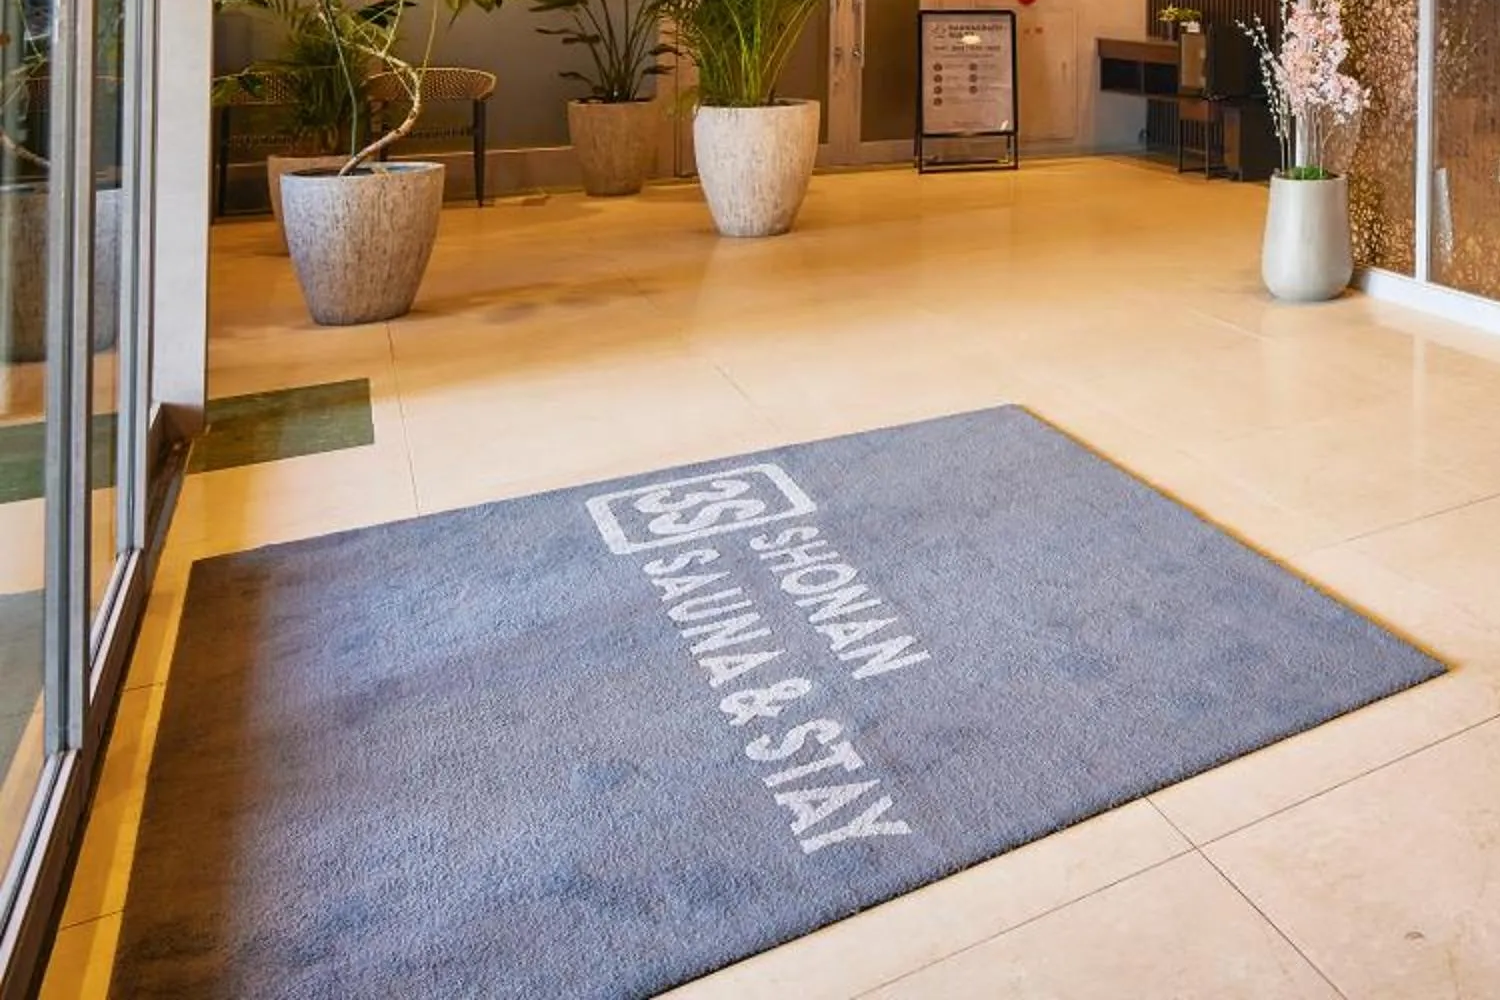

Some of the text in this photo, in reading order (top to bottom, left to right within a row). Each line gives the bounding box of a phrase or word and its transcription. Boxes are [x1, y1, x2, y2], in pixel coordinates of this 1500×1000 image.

[632, 479, 767, 536] 3S
[749, 526, 931, 681] SHONAN
[642, 548, 913, 855] SAUNA & STAY
